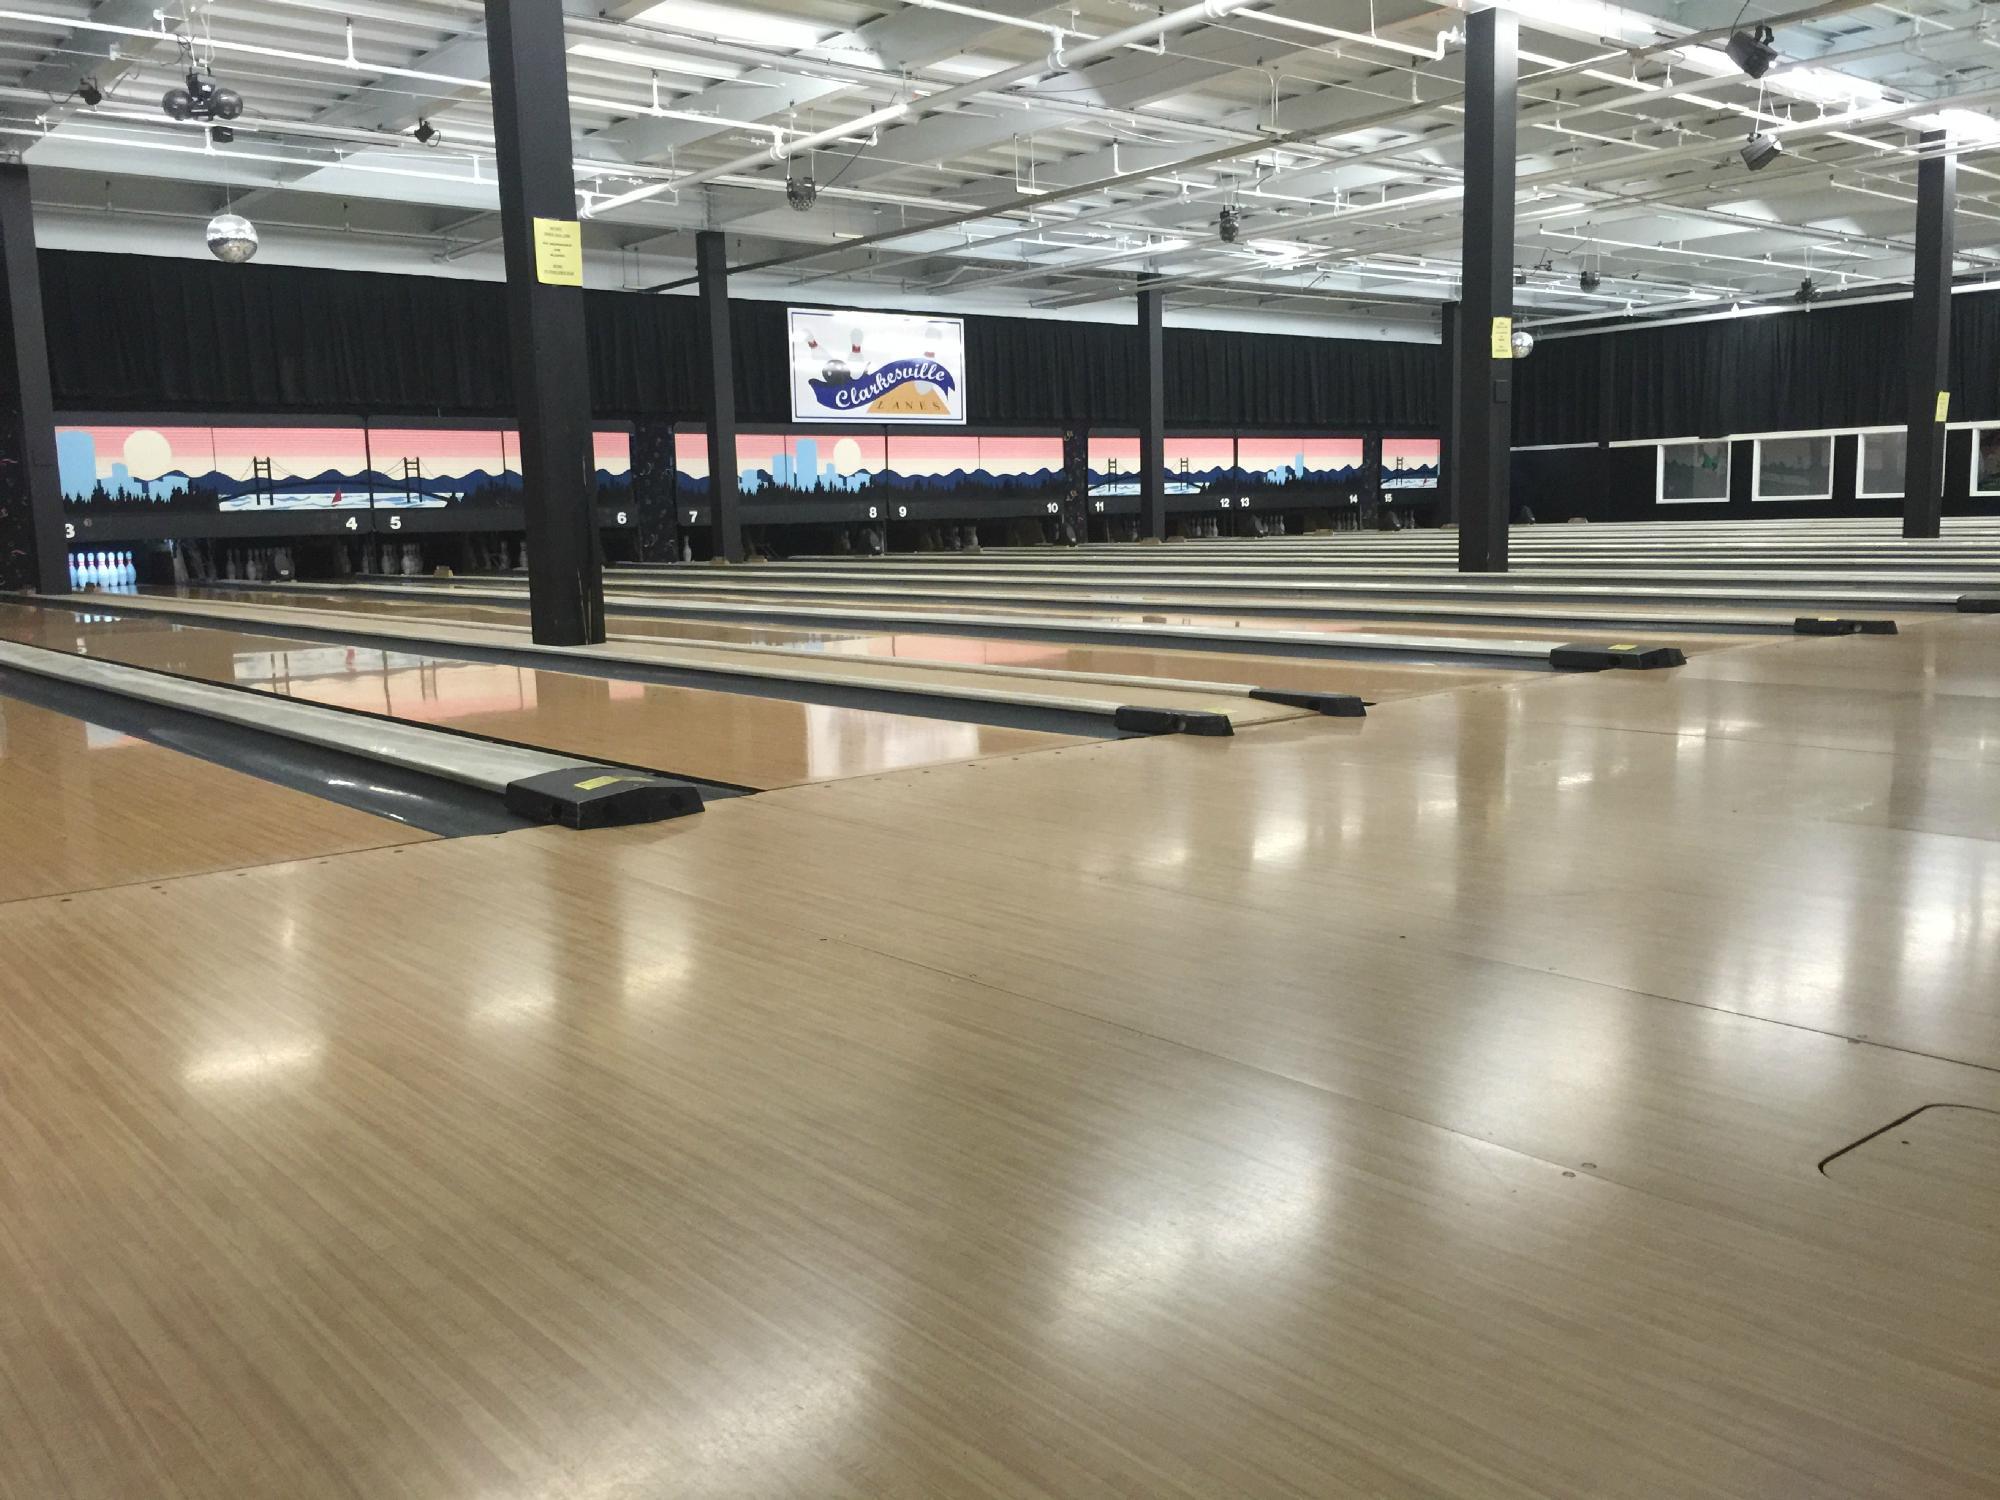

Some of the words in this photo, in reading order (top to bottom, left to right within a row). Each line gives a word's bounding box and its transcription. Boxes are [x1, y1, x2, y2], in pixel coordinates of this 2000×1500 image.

[835, 362, 945, 408] Clarkesville
[877, 400, 941, 411] LANES
[1219, 497, 1230, 508] 12
[1240, 497, 1250, 508] 13
[1349, 494, 1358, 504] 14
[868, 506, 878, 519] 8
[898, 506, 907, 518] 9
[1046, 502, 1059, 514] 10
[1094, 501, 1104, 512] 11
[390, 515, 402, 530] 5
[616, 511, 627, 525] 6
[688, 510, 698, 523] 7
[345, 516, 358, 530] 4
[64, 523, 76, 539] 3
